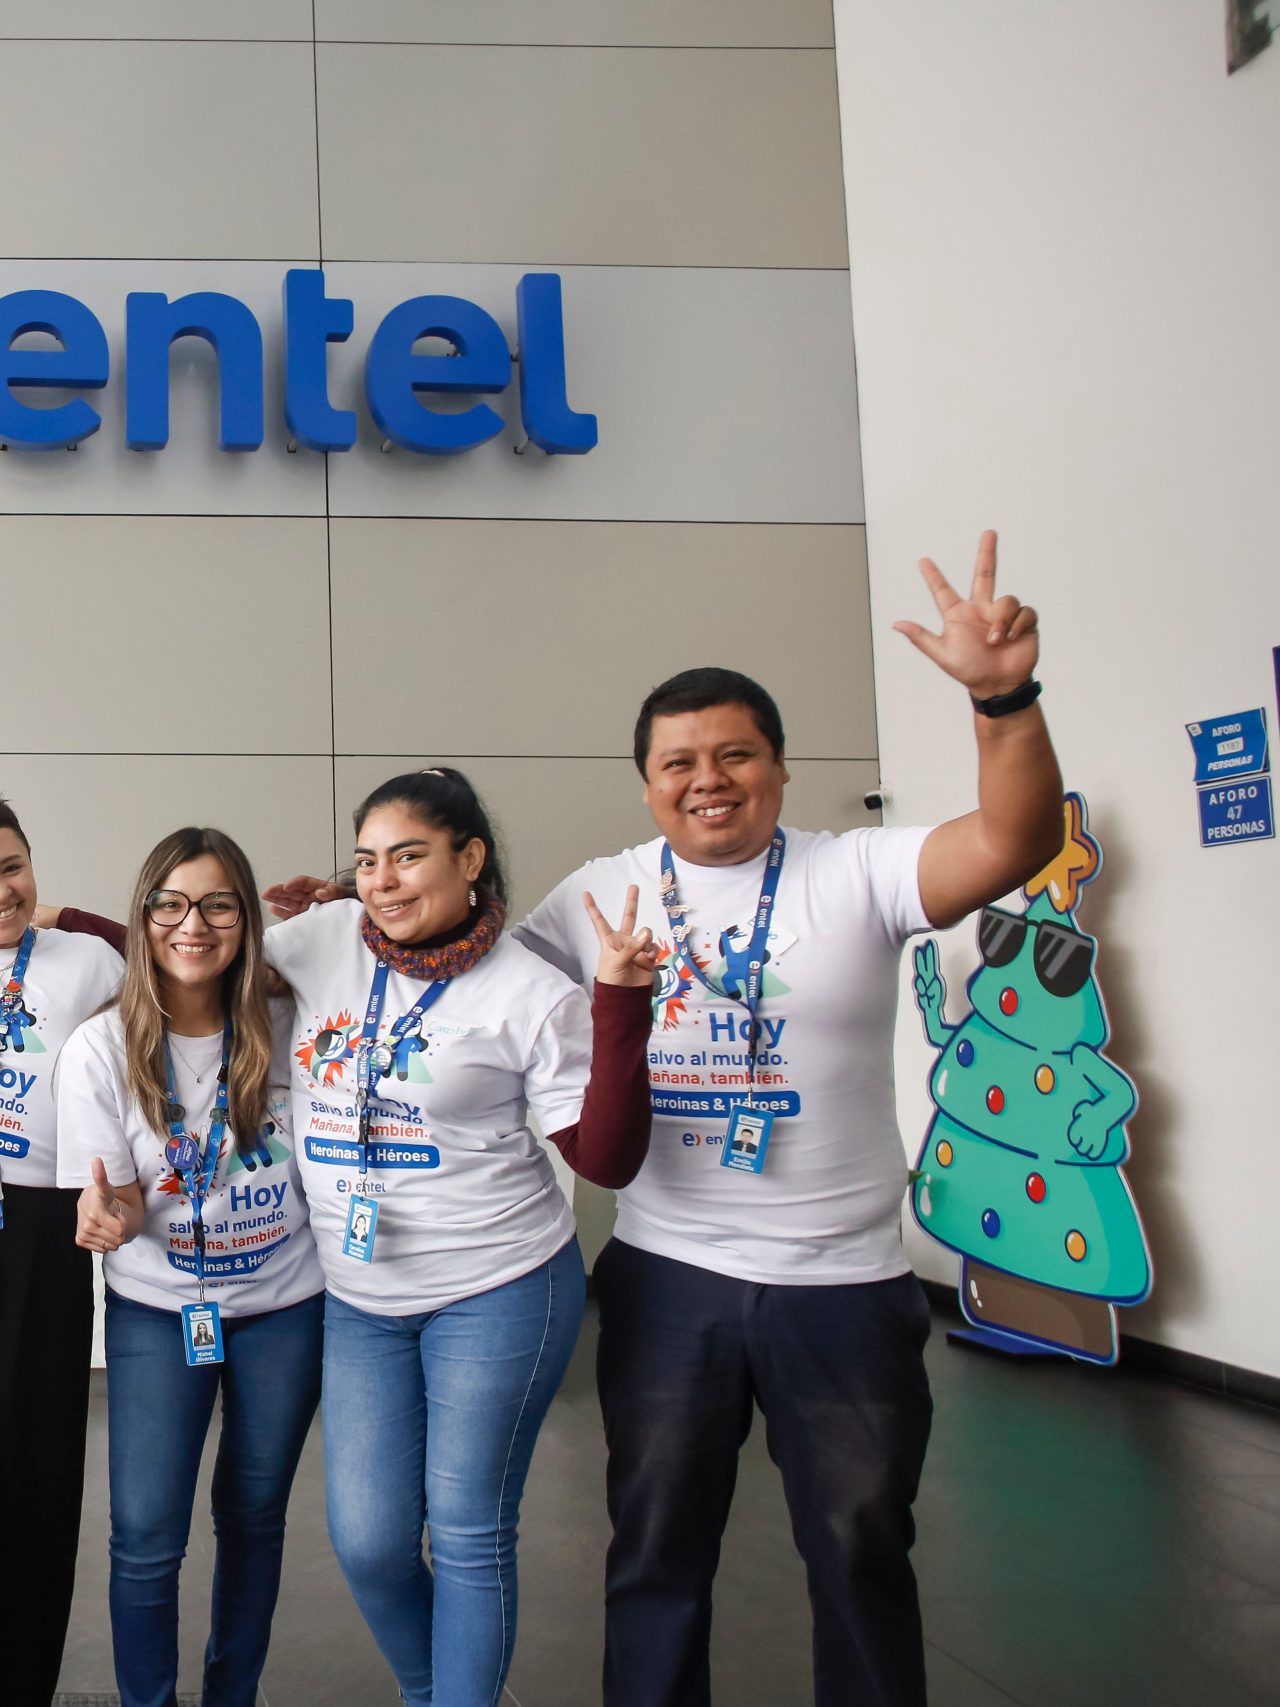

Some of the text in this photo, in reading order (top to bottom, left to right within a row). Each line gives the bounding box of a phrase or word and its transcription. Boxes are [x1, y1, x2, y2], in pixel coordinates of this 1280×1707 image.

[1212, 723, 1241, 737] AFORO
[1208, 755, 1253, 771] PERSONAS
[1209, 786, 1257, 805] AFORO
[1226, 805, 1243, 820] 47
[1208, 820, 1265, 839] PERSONAS
[770, 849, 780, 867] entel
[758, 908, 768, 929] entel
[748, 975, 757, 998] entel
[370, 994, 379, 1012] entel
[397, 1016, 414, 1034] entel
[709, 1012, 786, 1049] Hoy
[648, 1050, 684, 1065] alvo
[690, 1051, 706, 1065] al
[648, 1070, 705, 1086] añana,
[345, 1103, 358, 1118] al
[713, 1098, 725, 1111] &
[310, 1117, 428, 1138] Mañana, ambién.
[310, 1142, 359, 1160] Heroínas
[376, 1148, 430, 1162] Héroes
[230, 1181, 288, 1212] Hoy
[356, 1182, 386, 1193] entel
[168, 1210, 288, 1234] salo al mundo.
[169, 1225, 287, 1250] Mañna, también.
[174, 1256, 231, 1272] Herínas
[234, 1258, 245, 1269] &
